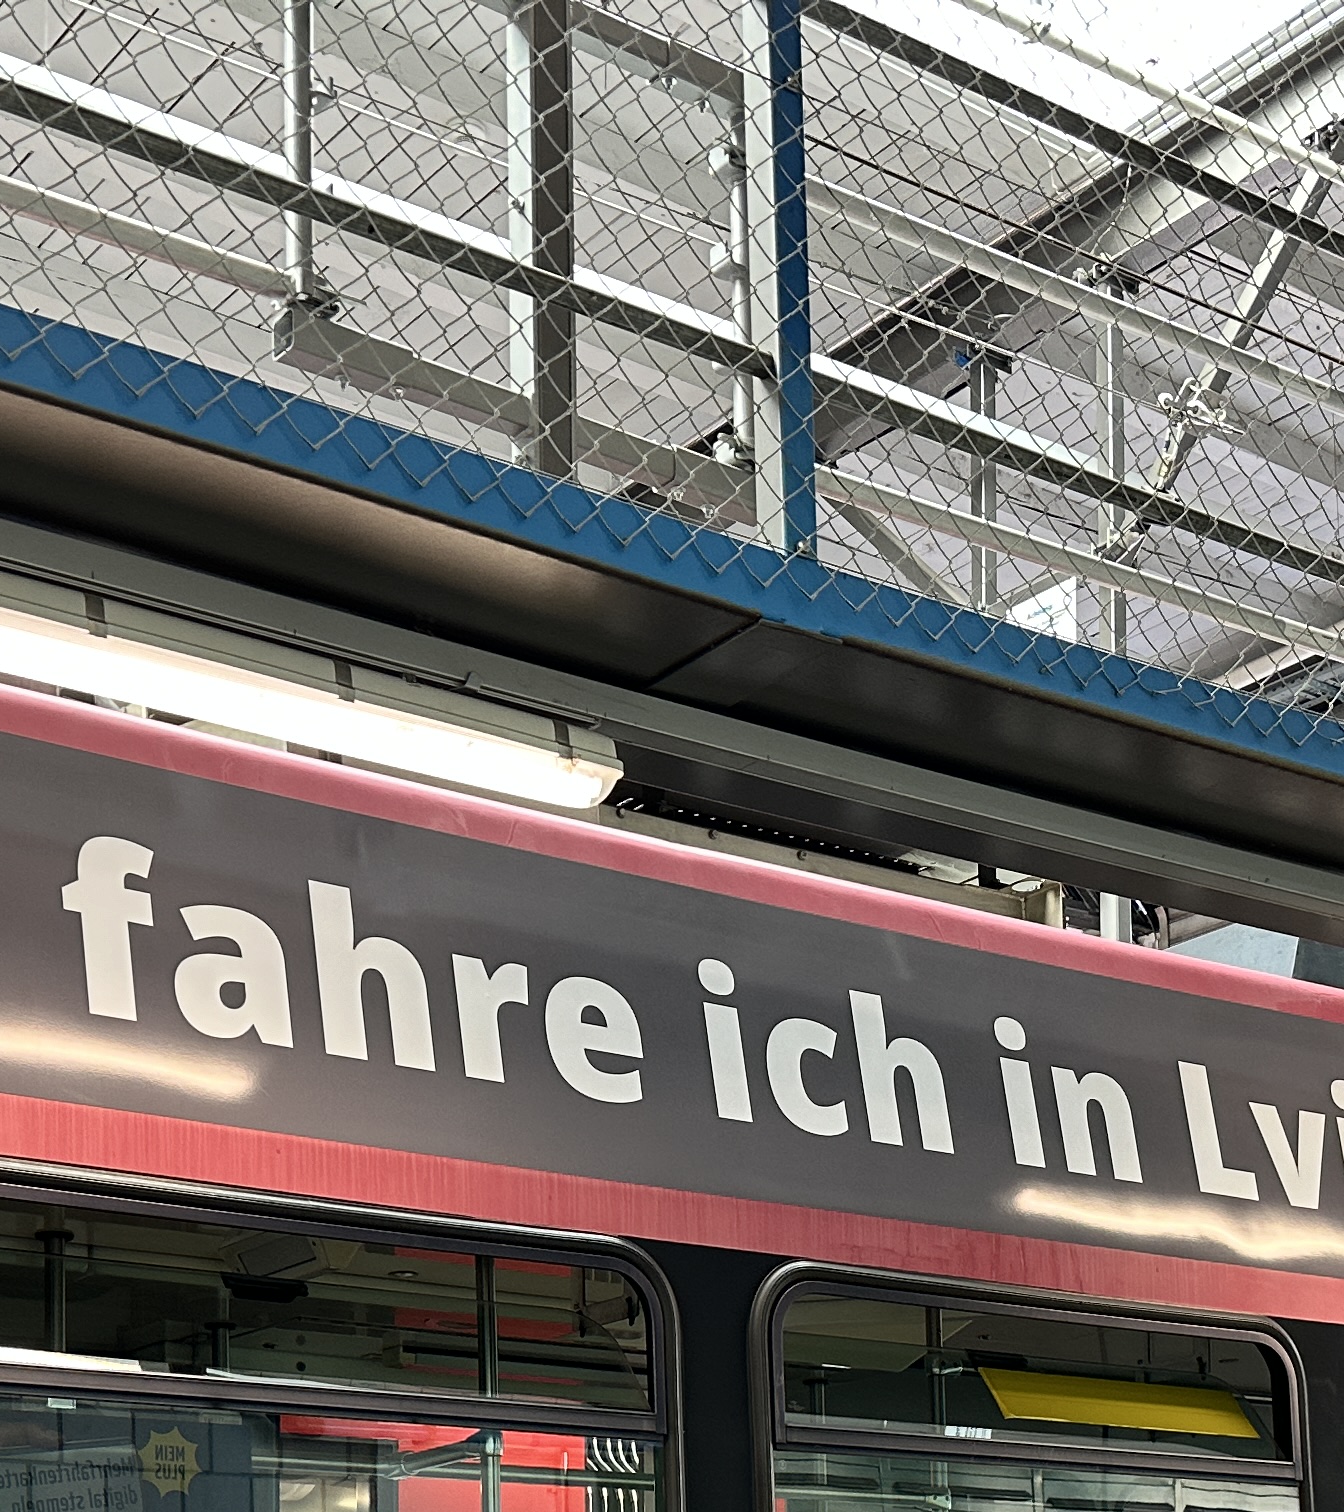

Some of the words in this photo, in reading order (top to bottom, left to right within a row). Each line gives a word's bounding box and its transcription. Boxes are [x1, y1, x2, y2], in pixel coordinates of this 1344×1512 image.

[61, 834, 644, 1106] fahre
[696, 957, 955, 1156] ich
[992, 1015, 1144, 1185] in
